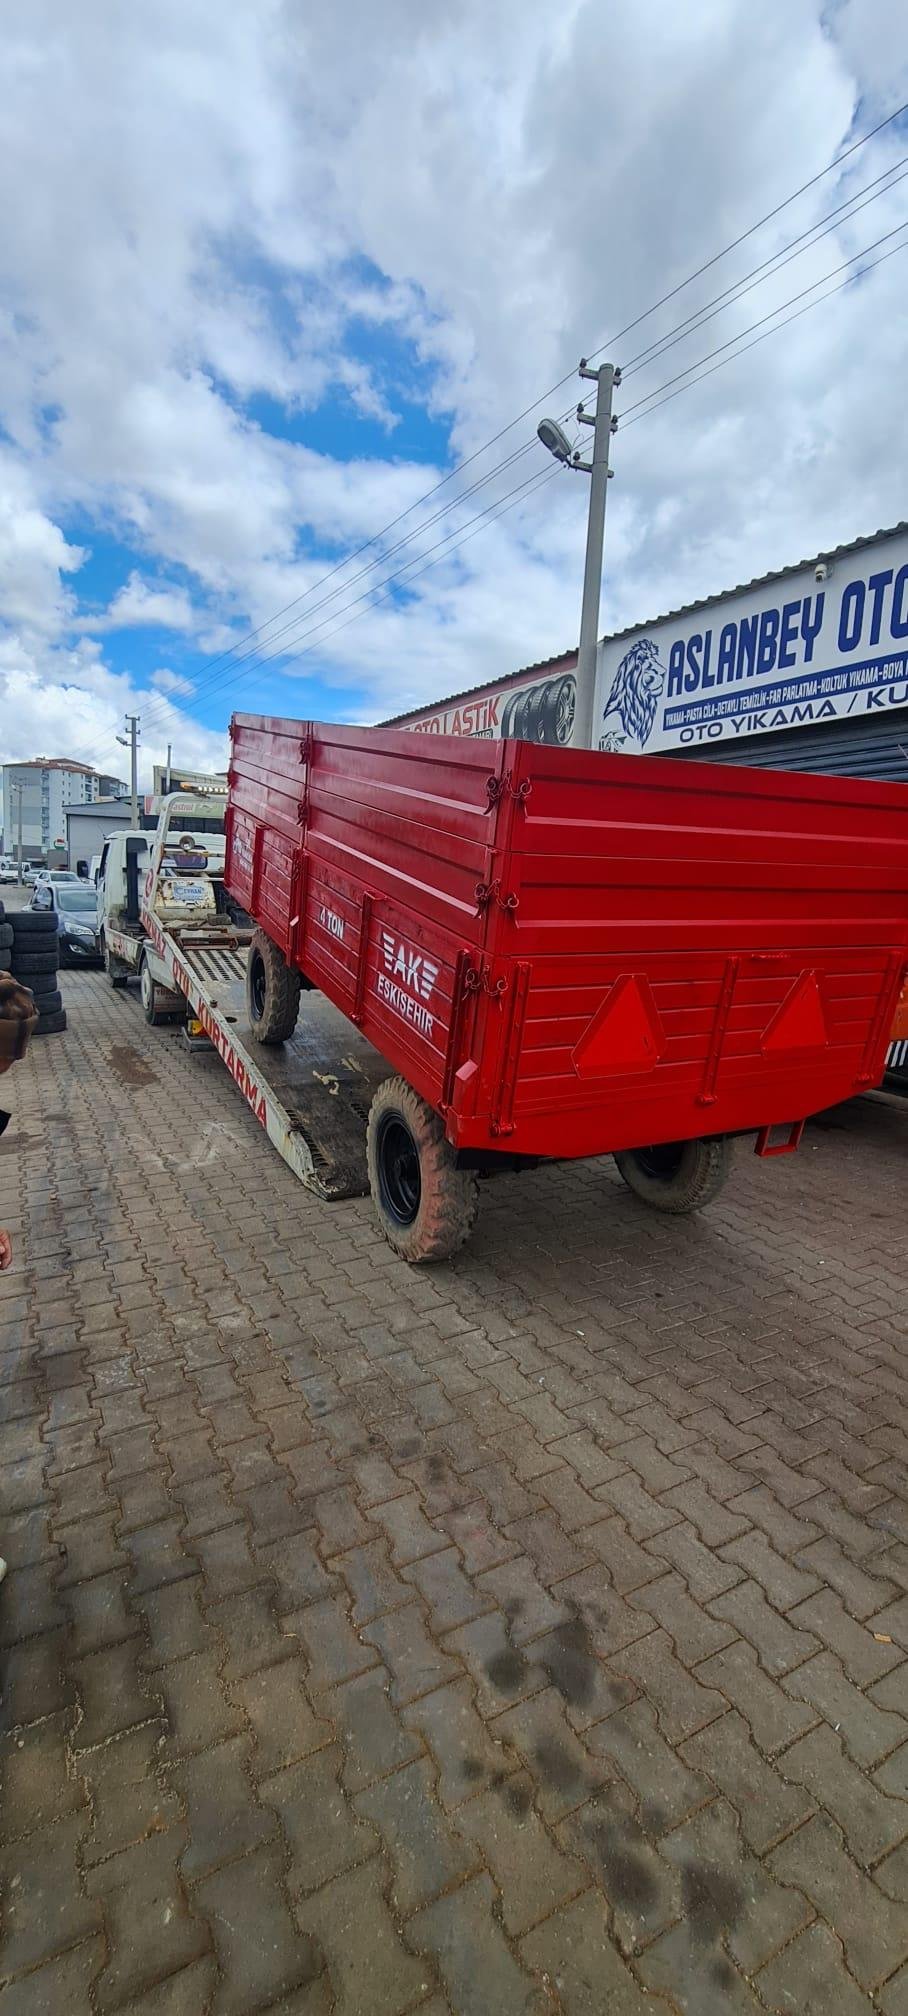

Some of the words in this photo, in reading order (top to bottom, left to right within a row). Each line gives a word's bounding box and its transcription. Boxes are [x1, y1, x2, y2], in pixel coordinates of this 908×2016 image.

[667, 592, 825, 697] ASLANBEY
[680, 721, 723, 743] OTO
[730, 699, 837, 733] YIKAMA
[320, 907, 326, 925] 4
[327, 910, 344, 940] TON
[197, 997, 267, 1129] KURTARMA
